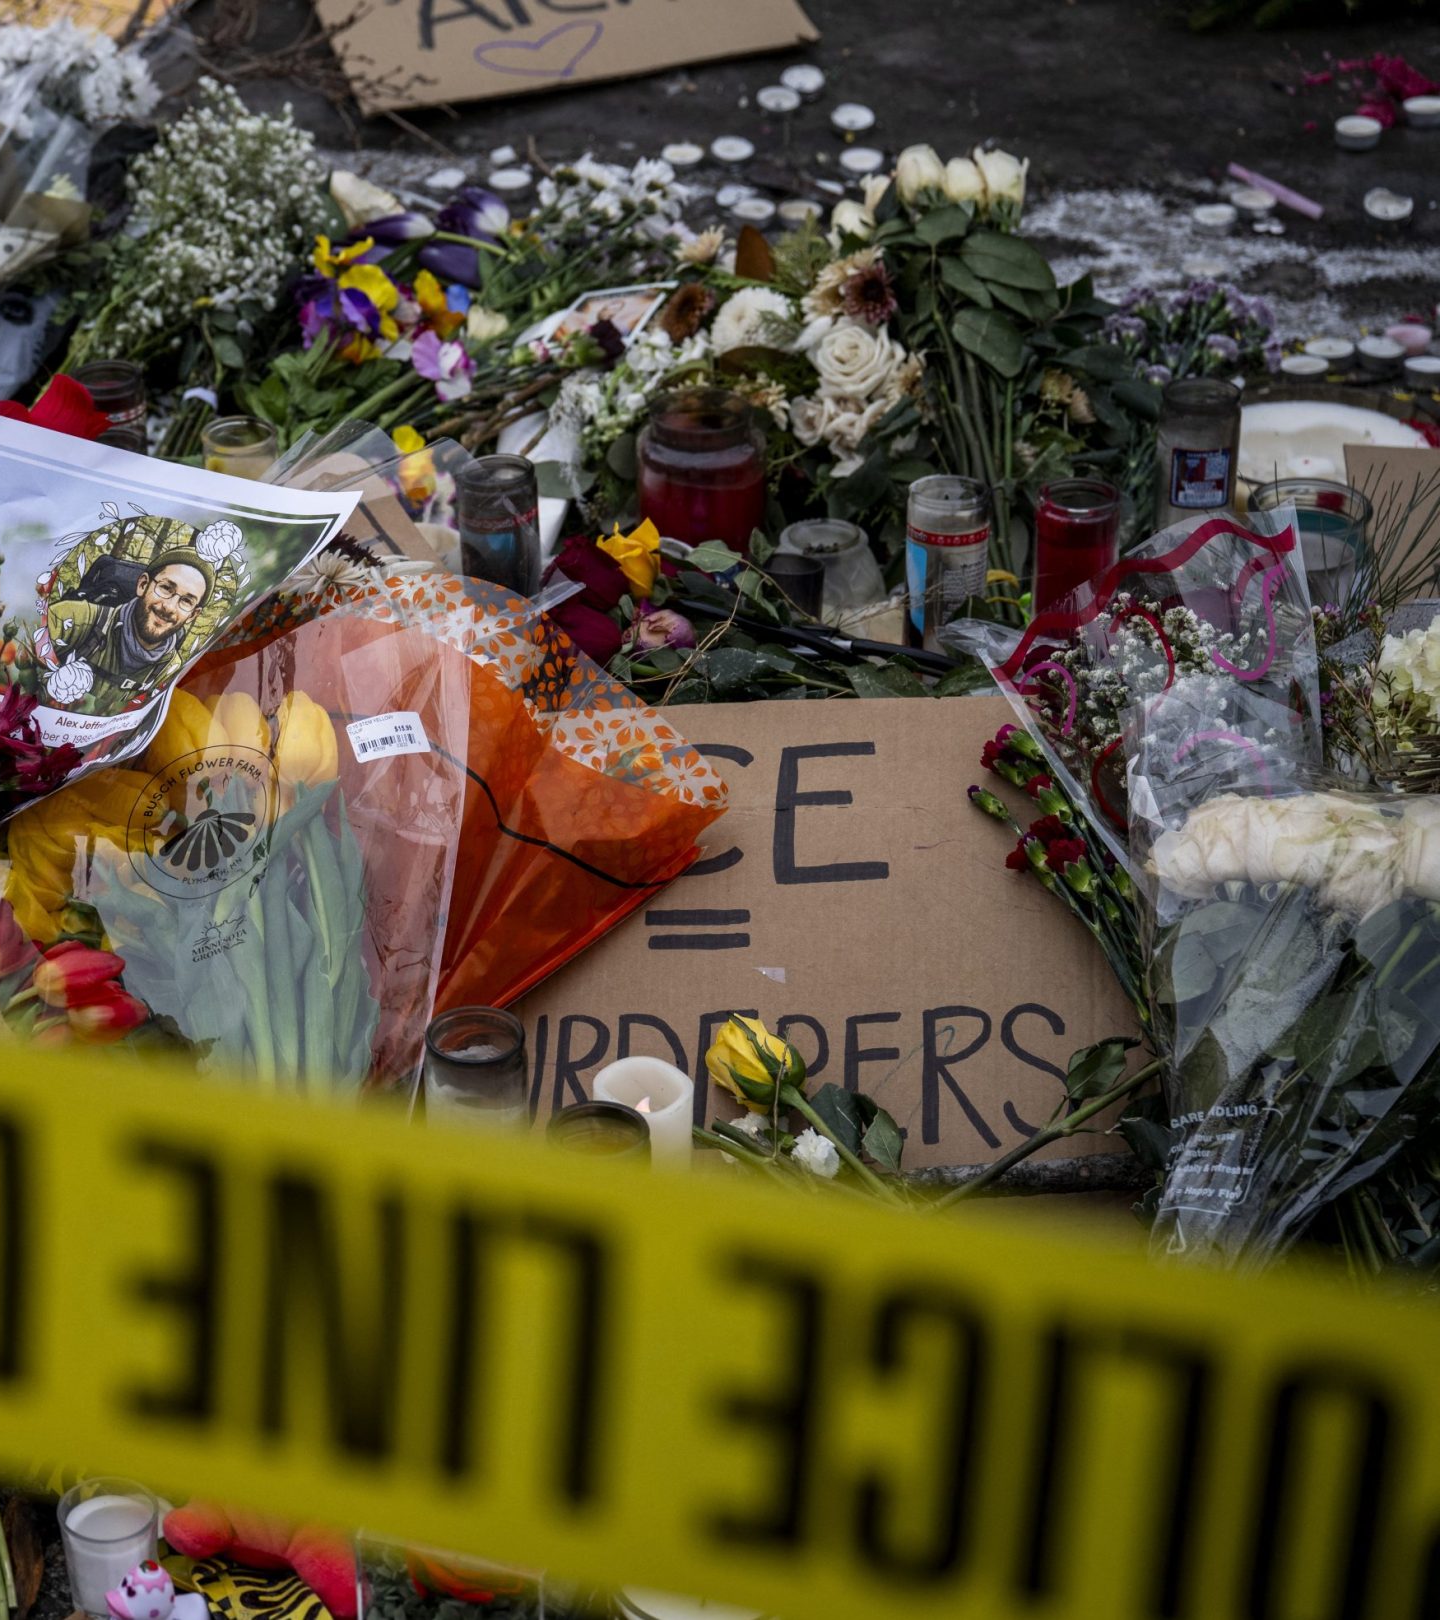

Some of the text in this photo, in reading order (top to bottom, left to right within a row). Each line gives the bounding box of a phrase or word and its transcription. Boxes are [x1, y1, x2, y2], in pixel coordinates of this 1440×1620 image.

[55, 716, 78, 728] Alex
[143, 757, 262, 818] BUSCH FLOWER FARM
[191, 944, 231, 963] GROWN
[1169, 1110, 1205, 1129] CARE
[1184, 1186, 1215, 1198] Happy
[130, 1132, 610, 1510] LINE
[710, 1246, 1440, 1620] OLICE
